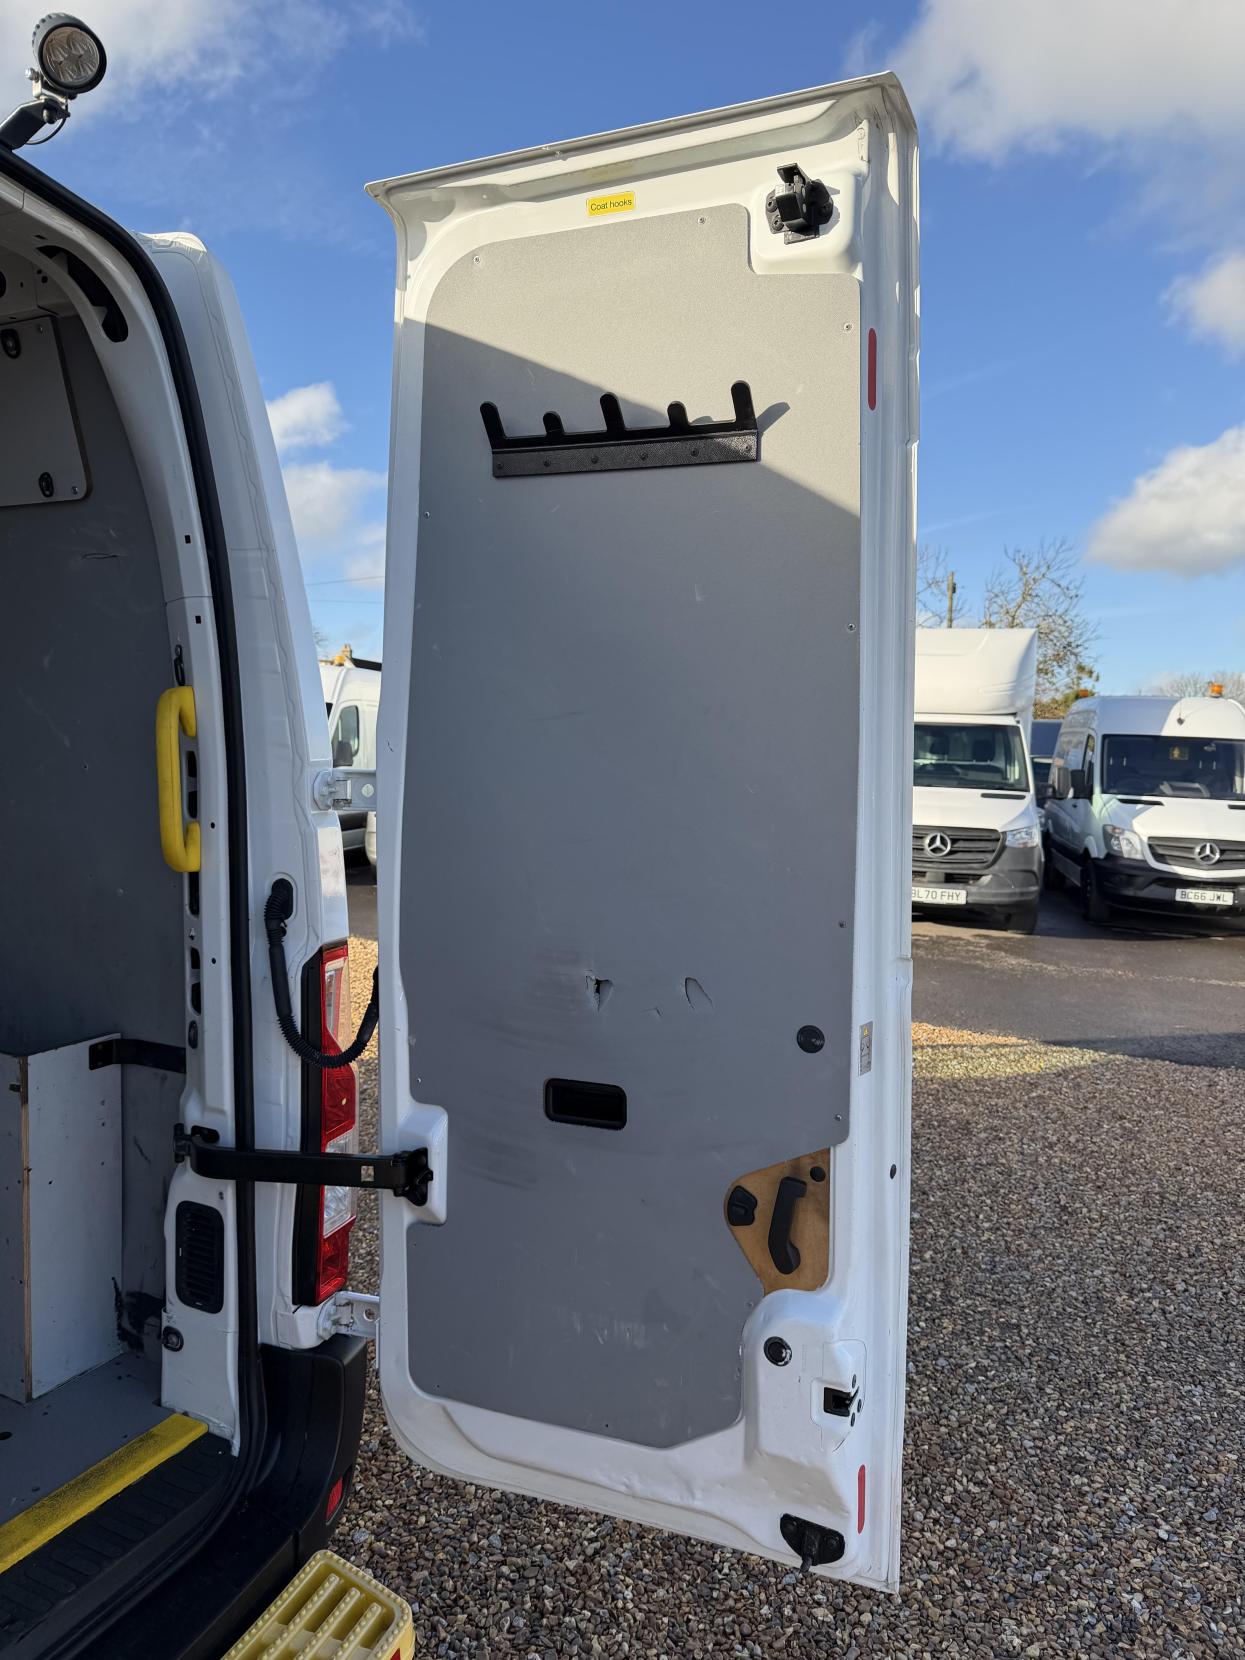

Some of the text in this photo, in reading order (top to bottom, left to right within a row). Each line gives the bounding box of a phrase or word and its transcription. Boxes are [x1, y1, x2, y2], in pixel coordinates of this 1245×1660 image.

[590, 198, 633, 211] Coat hooks
[940, 891, 961, 901] FHY
[1180, 890, 1229, 903] BC66 JWL
